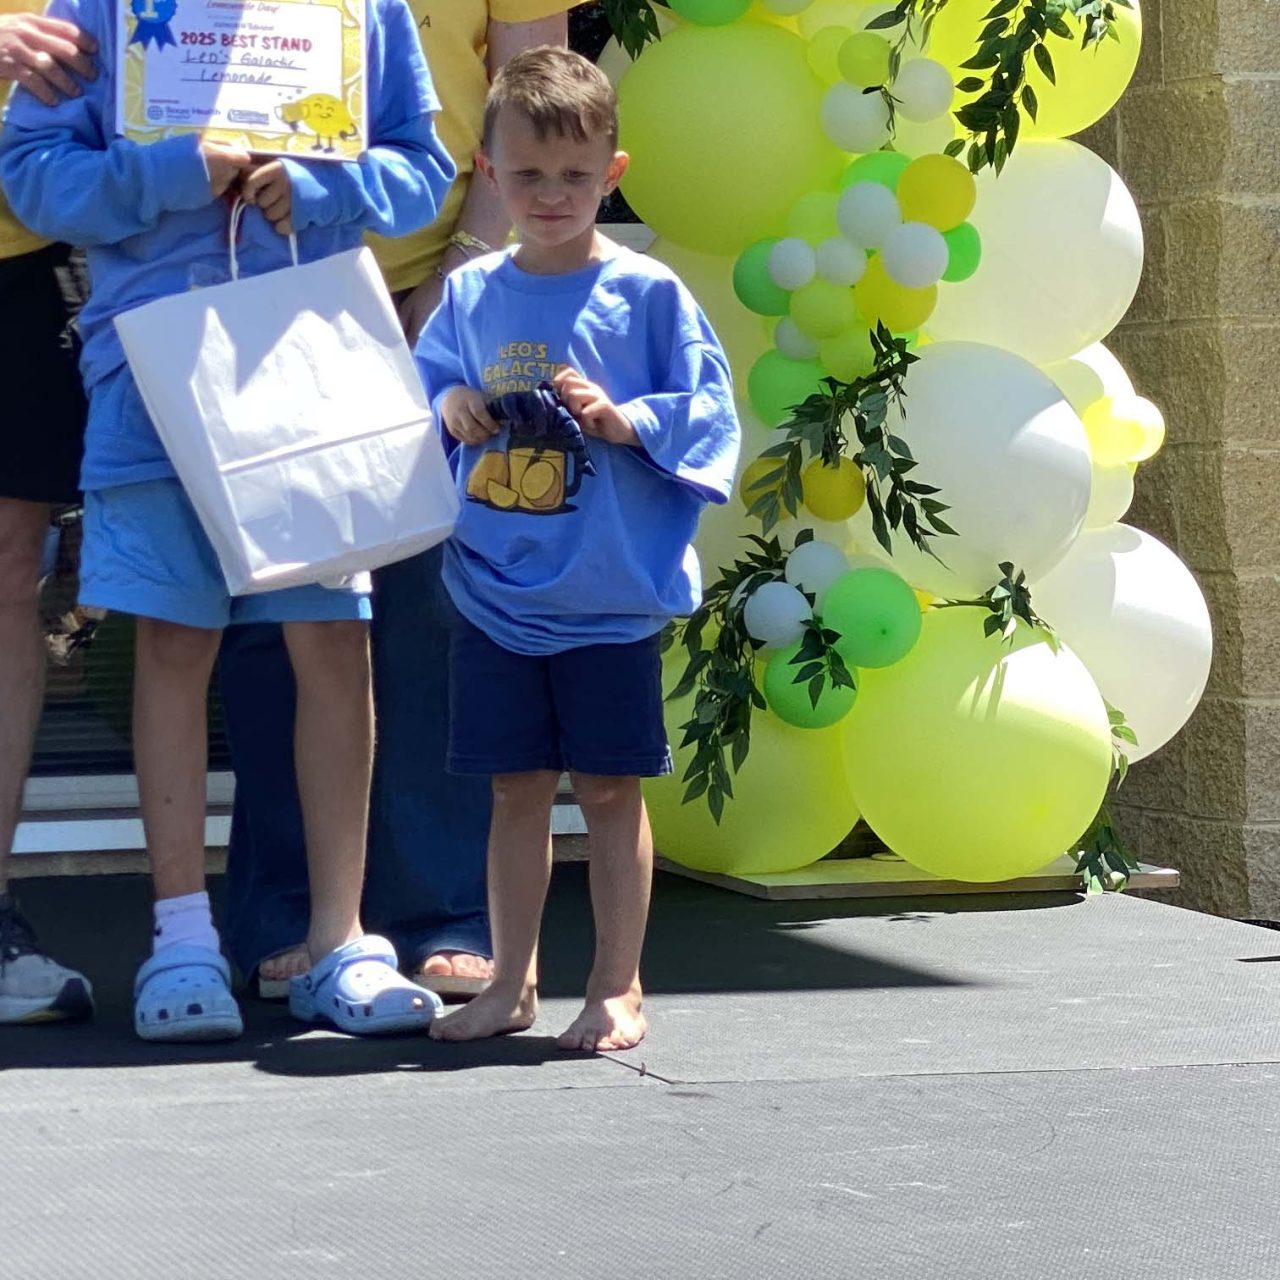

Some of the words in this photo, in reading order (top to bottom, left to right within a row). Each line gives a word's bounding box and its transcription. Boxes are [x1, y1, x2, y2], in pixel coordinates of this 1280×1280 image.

[180, 31, 217, 46] 2025
[221, 32, 258, 48] BEST
[261, 35, 312, 52] STAND
[200, 68, 273, 84] Lemonade
[500, 342, 548, 359] LEO'S
